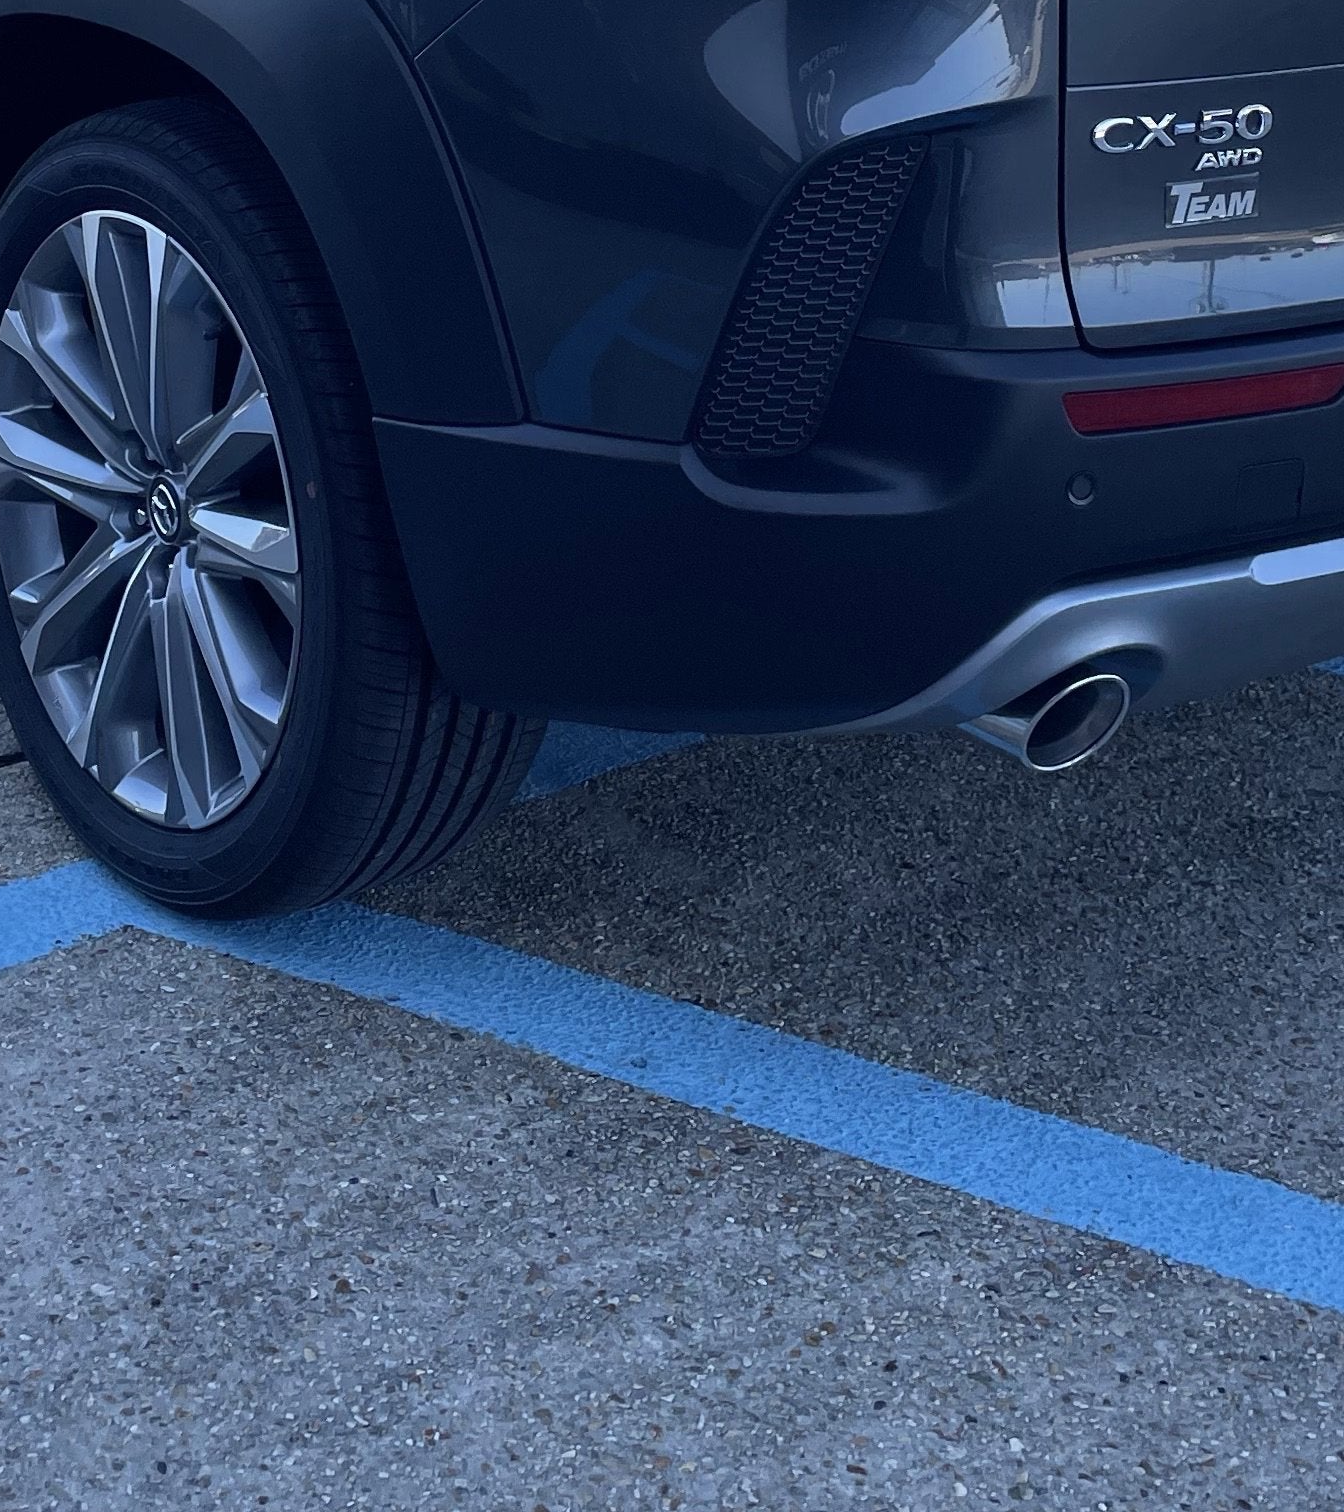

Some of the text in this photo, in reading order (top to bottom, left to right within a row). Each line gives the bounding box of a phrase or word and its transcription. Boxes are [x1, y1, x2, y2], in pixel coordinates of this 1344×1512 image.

[1092, 103, 1274, 155] CX-50
[1193, 146, 1264, 172] AWD
[1169, 180, 1258, 225] TEAM
